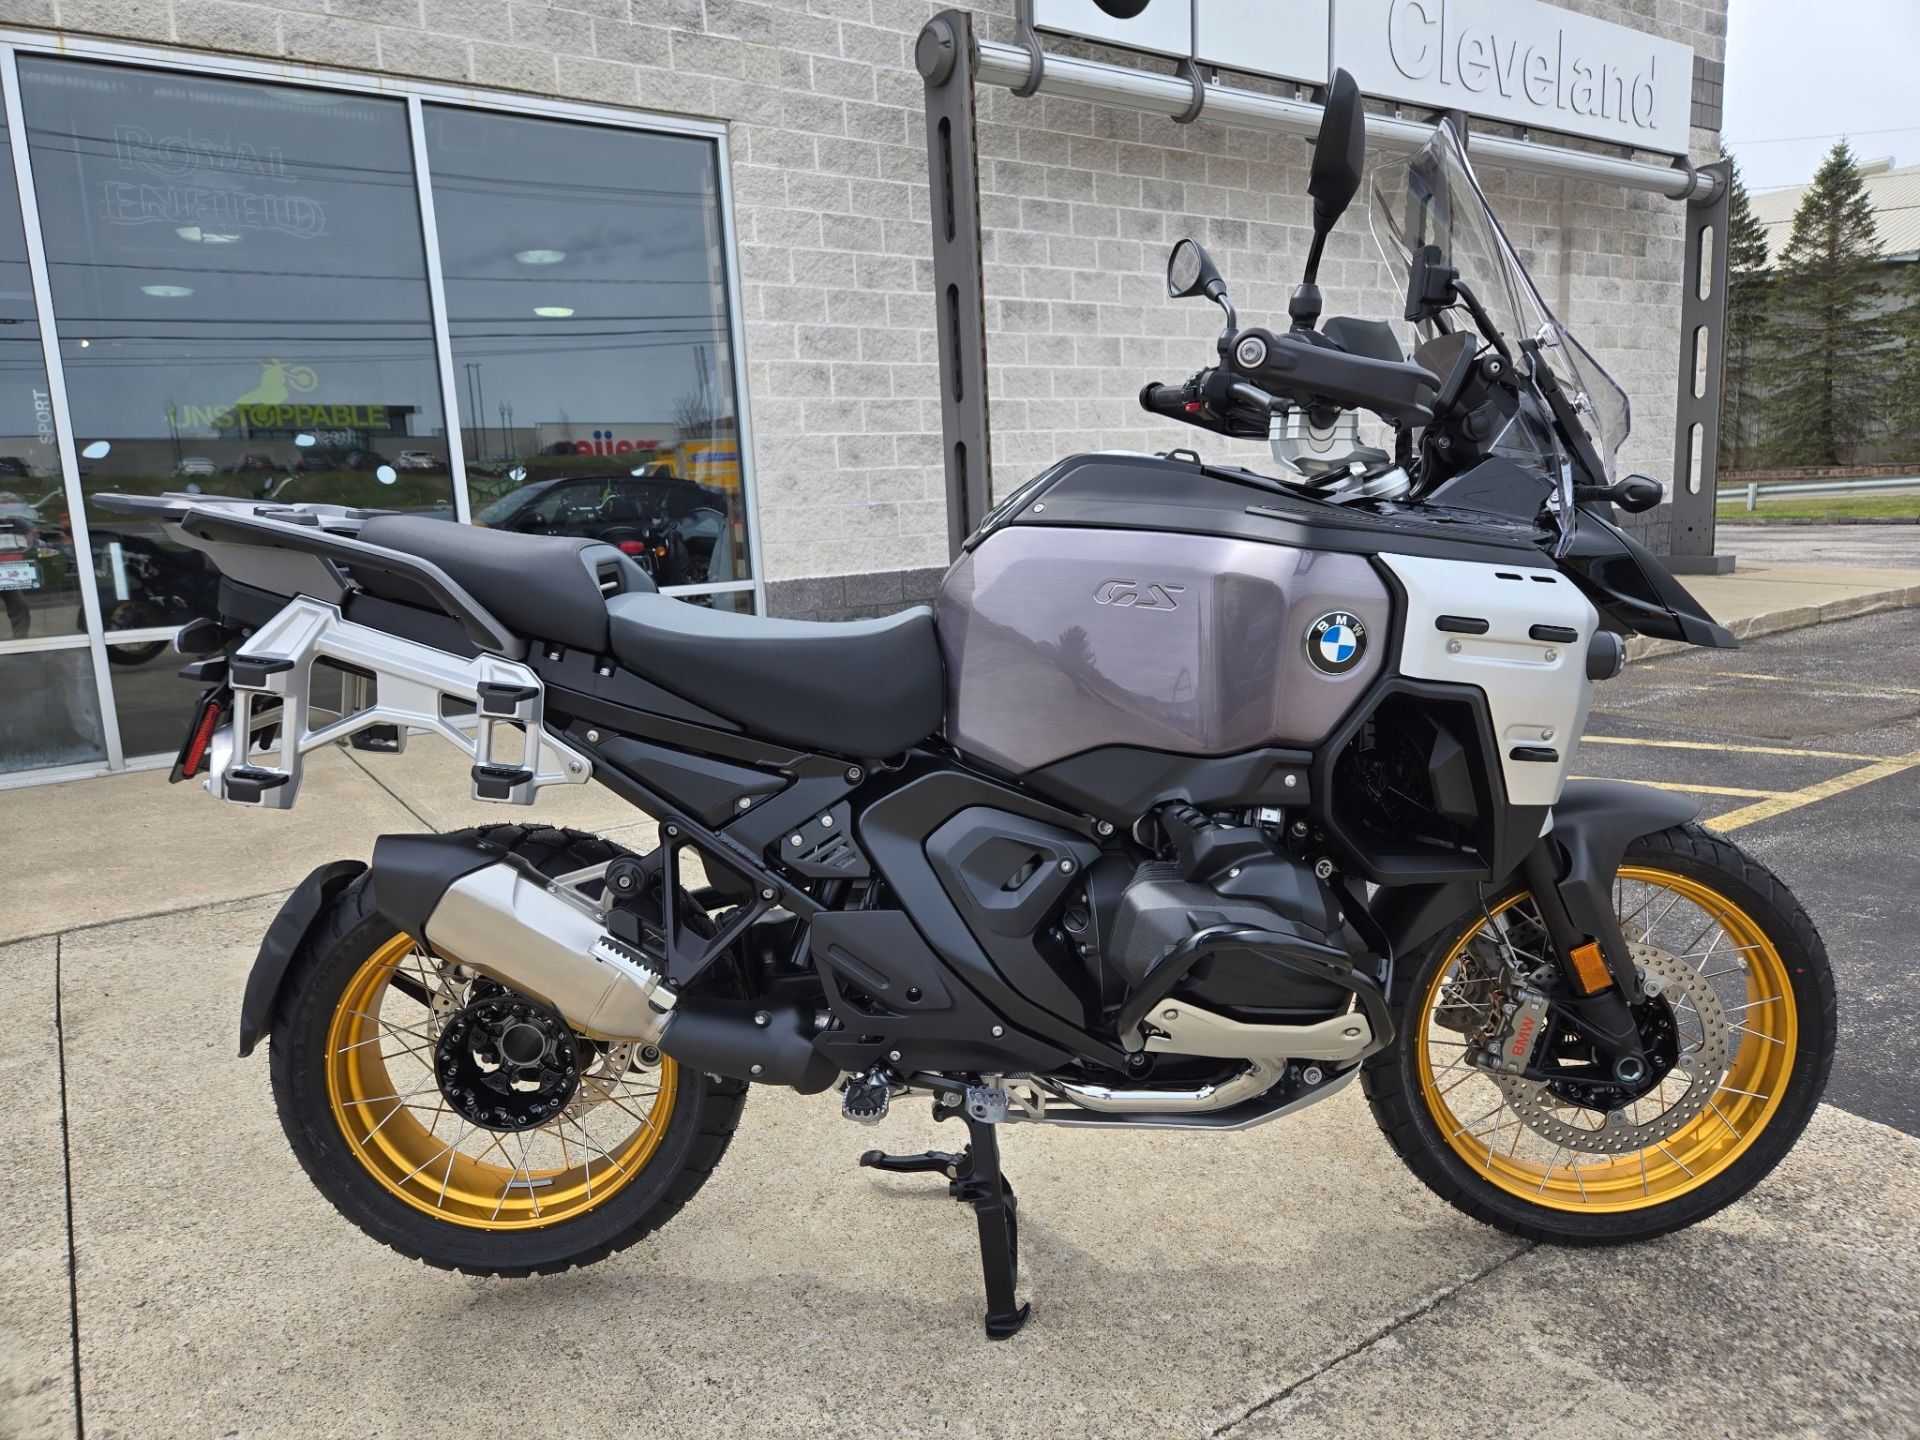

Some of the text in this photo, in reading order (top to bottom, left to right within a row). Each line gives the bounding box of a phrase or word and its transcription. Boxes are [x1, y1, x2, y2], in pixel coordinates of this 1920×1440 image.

[1388, 0, 1658, 129] Cleveland
[113, 124, 299, 184] ROYAL
[101, 180, 328, 239] ENFIELD
[32, 389, 55, 445] SPORT
[168, 404, 388, 431] UNSTOPPABLE
[1093, 578, 1186, 612] GS
[1317, 615, 1364, 637] BMW
[1511, 1016, 1536, 1057] BMW
